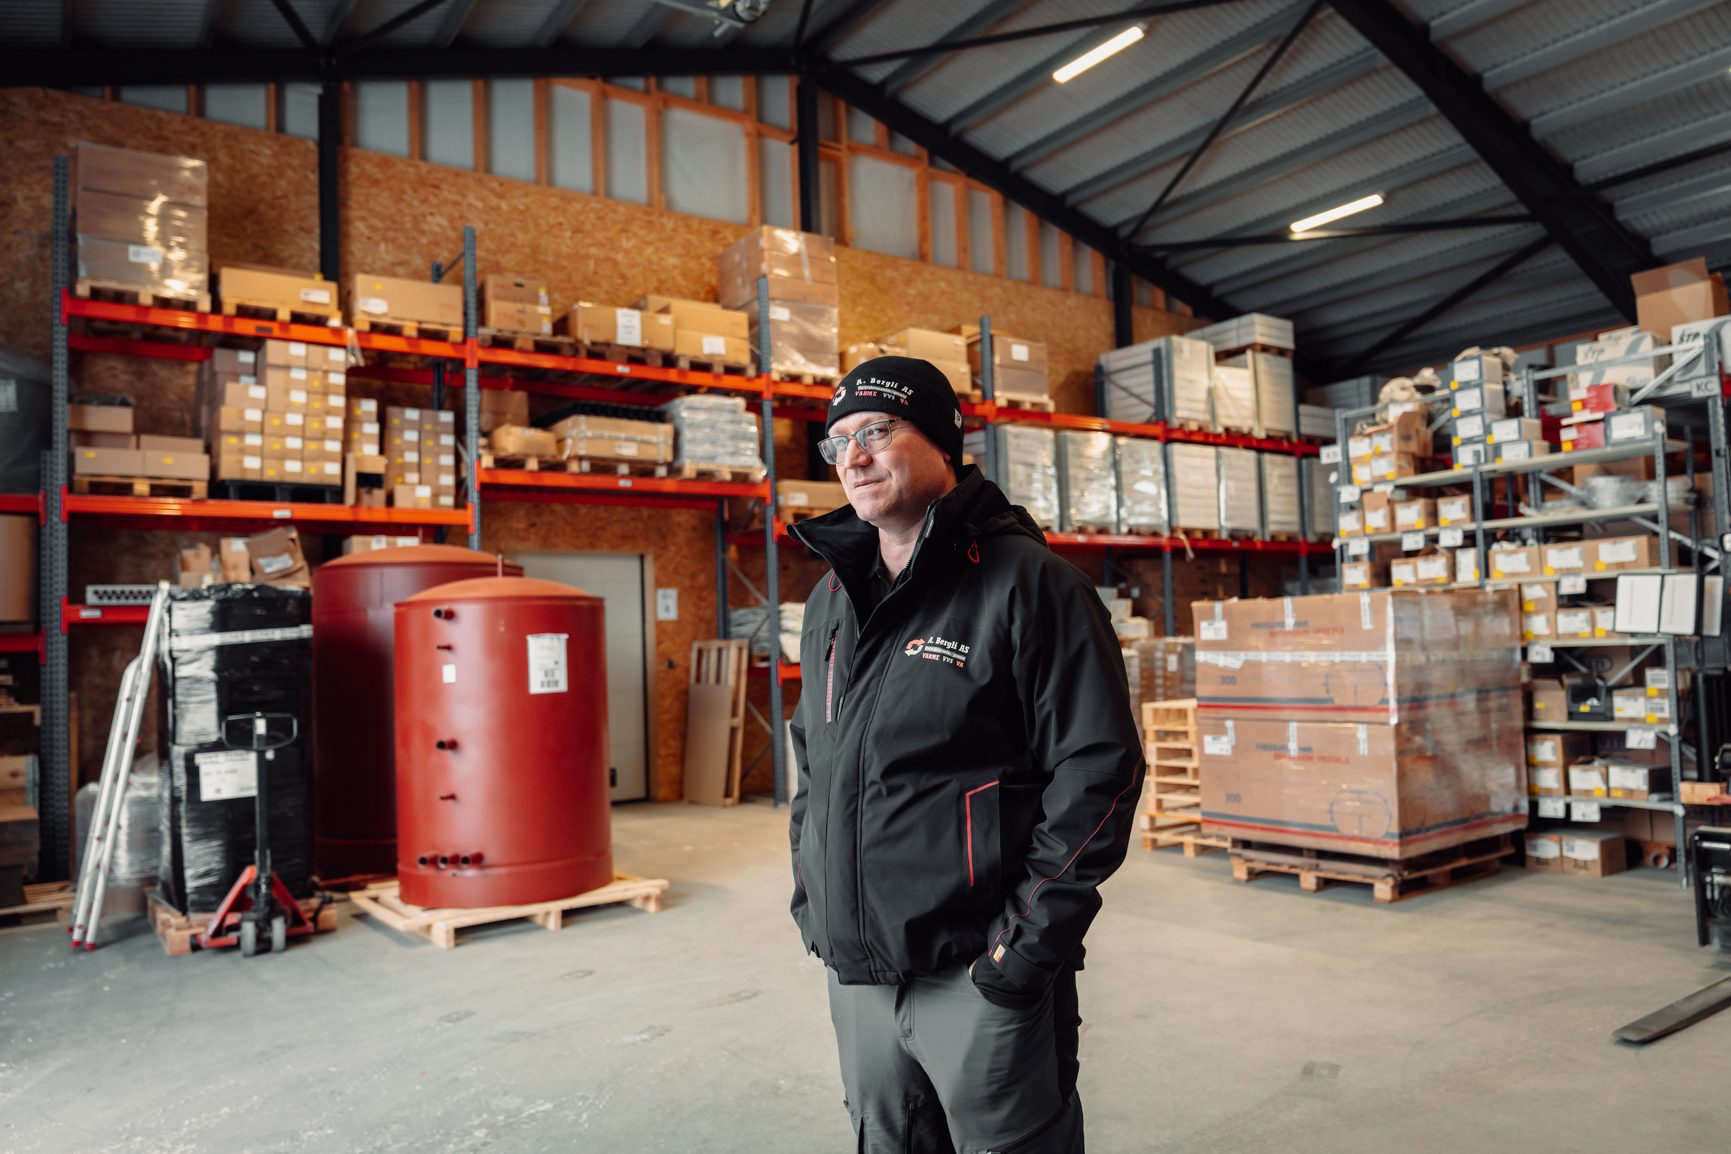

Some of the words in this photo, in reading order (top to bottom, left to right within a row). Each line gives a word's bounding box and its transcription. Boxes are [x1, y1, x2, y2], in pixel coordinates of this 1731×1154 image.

[870, 377, 898, 388] Bergli
[901, 386, 913, 395] AS
[935, 637, 957, 649] Bergli
[958, 644, 970, 654] AS
